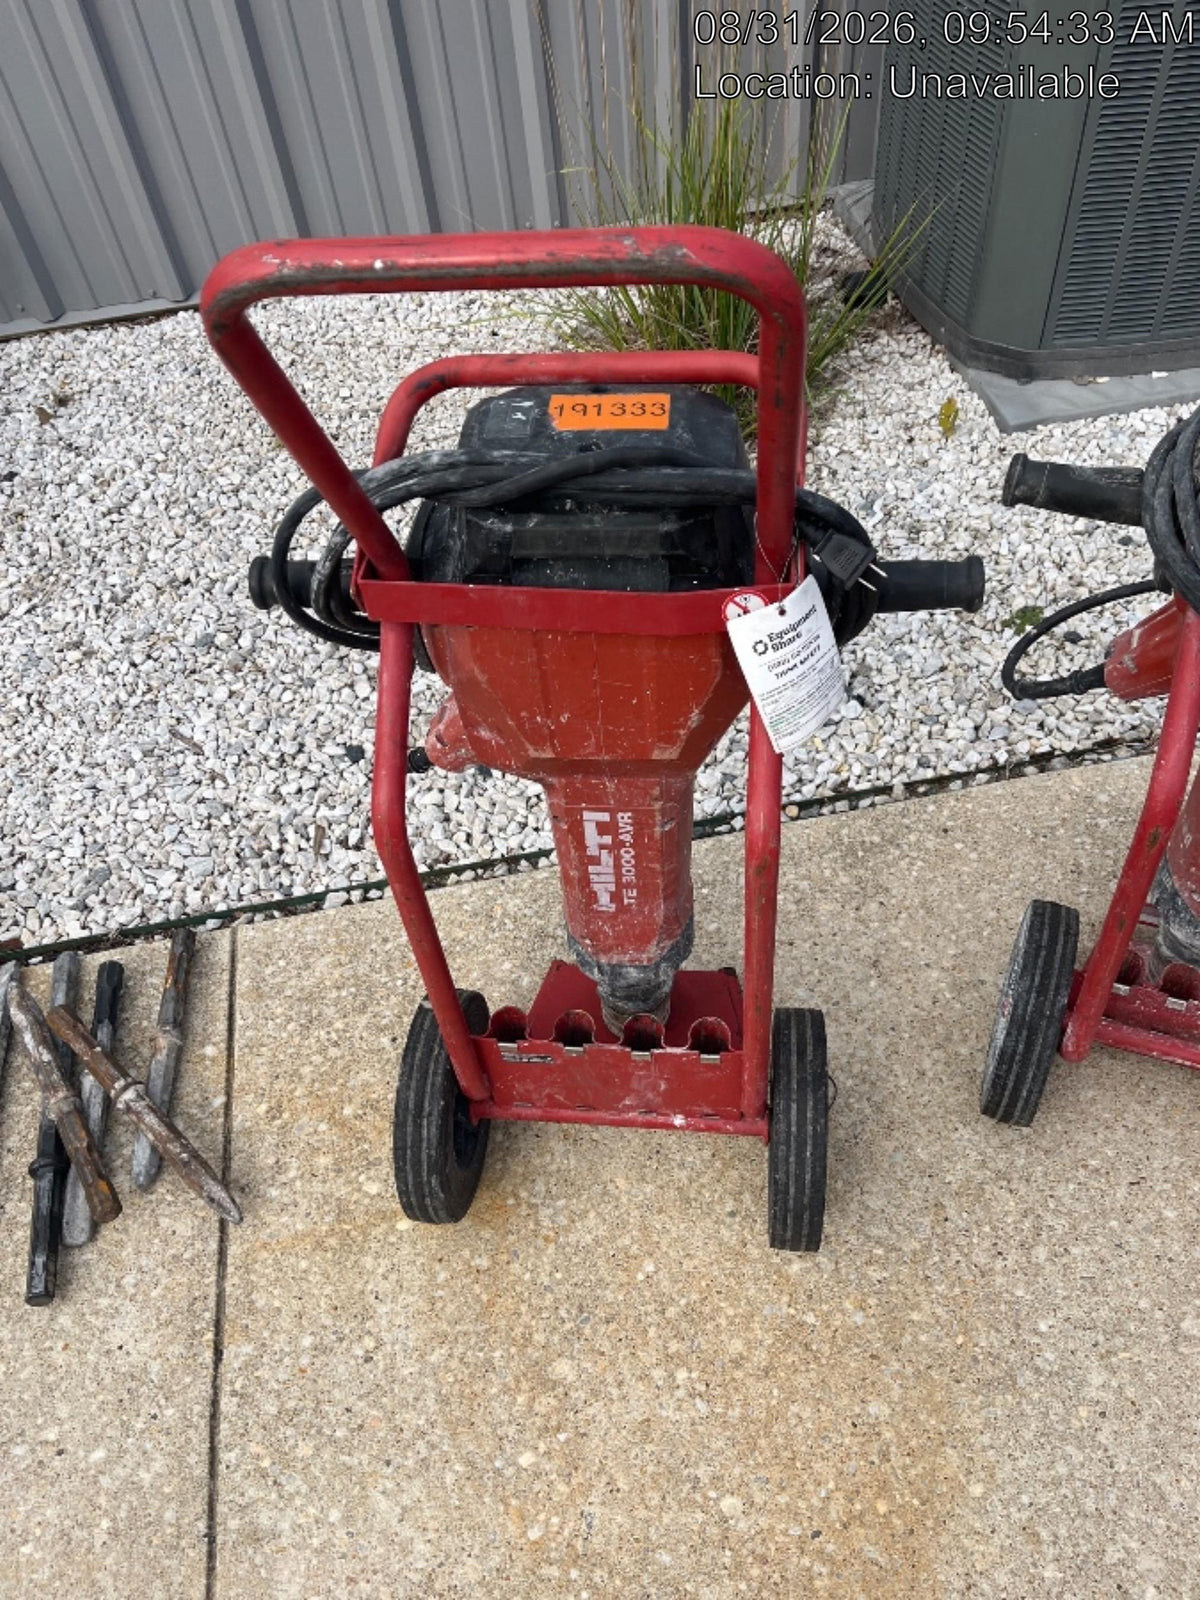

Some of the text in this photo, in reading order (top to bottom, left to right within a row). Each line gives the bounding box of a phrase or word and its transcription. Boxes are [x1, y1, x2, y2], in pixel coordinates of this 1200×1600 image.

[554, 402, 667, 417] 191333
[767, 604, 817, 642] Equipment
[771, 631, 802, 652] Share
[582, 811, 616, 912] HILTI
[622, 888, 637, 906] TE
